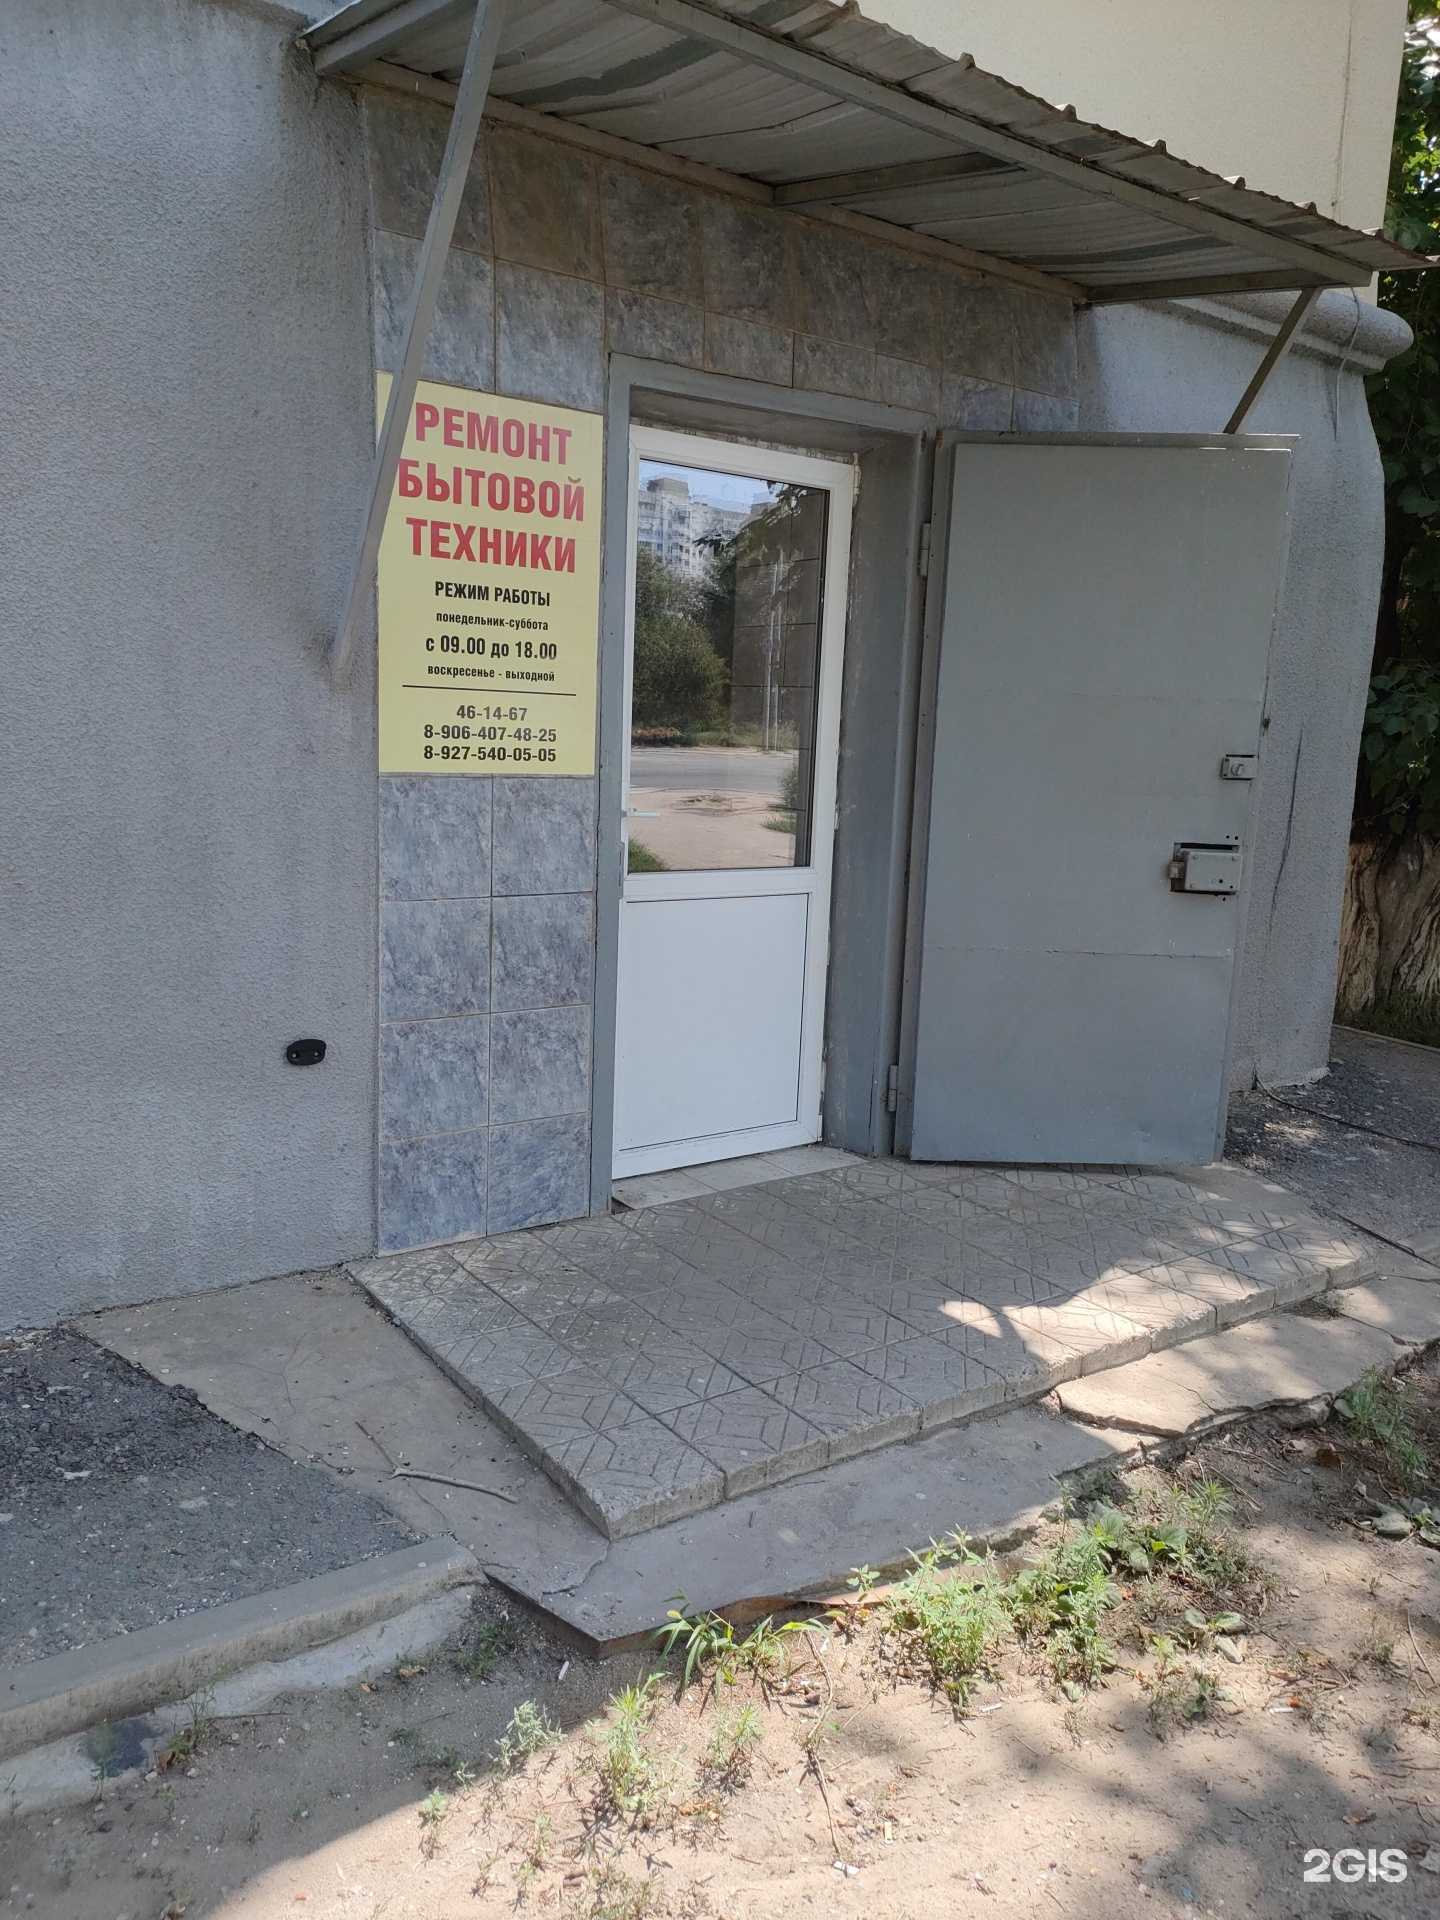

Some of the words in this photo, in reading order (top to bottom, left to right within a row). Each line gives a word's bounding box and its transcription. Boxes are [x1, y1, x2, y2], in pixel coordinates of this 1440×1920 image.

[415, 402, 572, 465] РЕМОНТ
[397, 457, 585, 522] БЫТОВОЙ
[406, 517, 576, 573] ТЕХНИКИ
[435, 581, 489, 601] РЕЖИМ
[494, 587, 551, 607] РАБОТЫ
[436, 612, 549, 631] понедельник-суббота
[426, 637, 435, 652] с
[440, 635, 486, 655] 09.00
[491, 642, 510, 659] до
[515, 641, 558, 660] 18.00
[427, 665, 495, 680] воскресенье
[505, 670, 555, 682] выходной
[456, 705, 528, 721] 46-14-67
[423, 724, 557, 743] 8-906-407-48-25
[423, 745, 557, 762] 8-927-540-05-05
